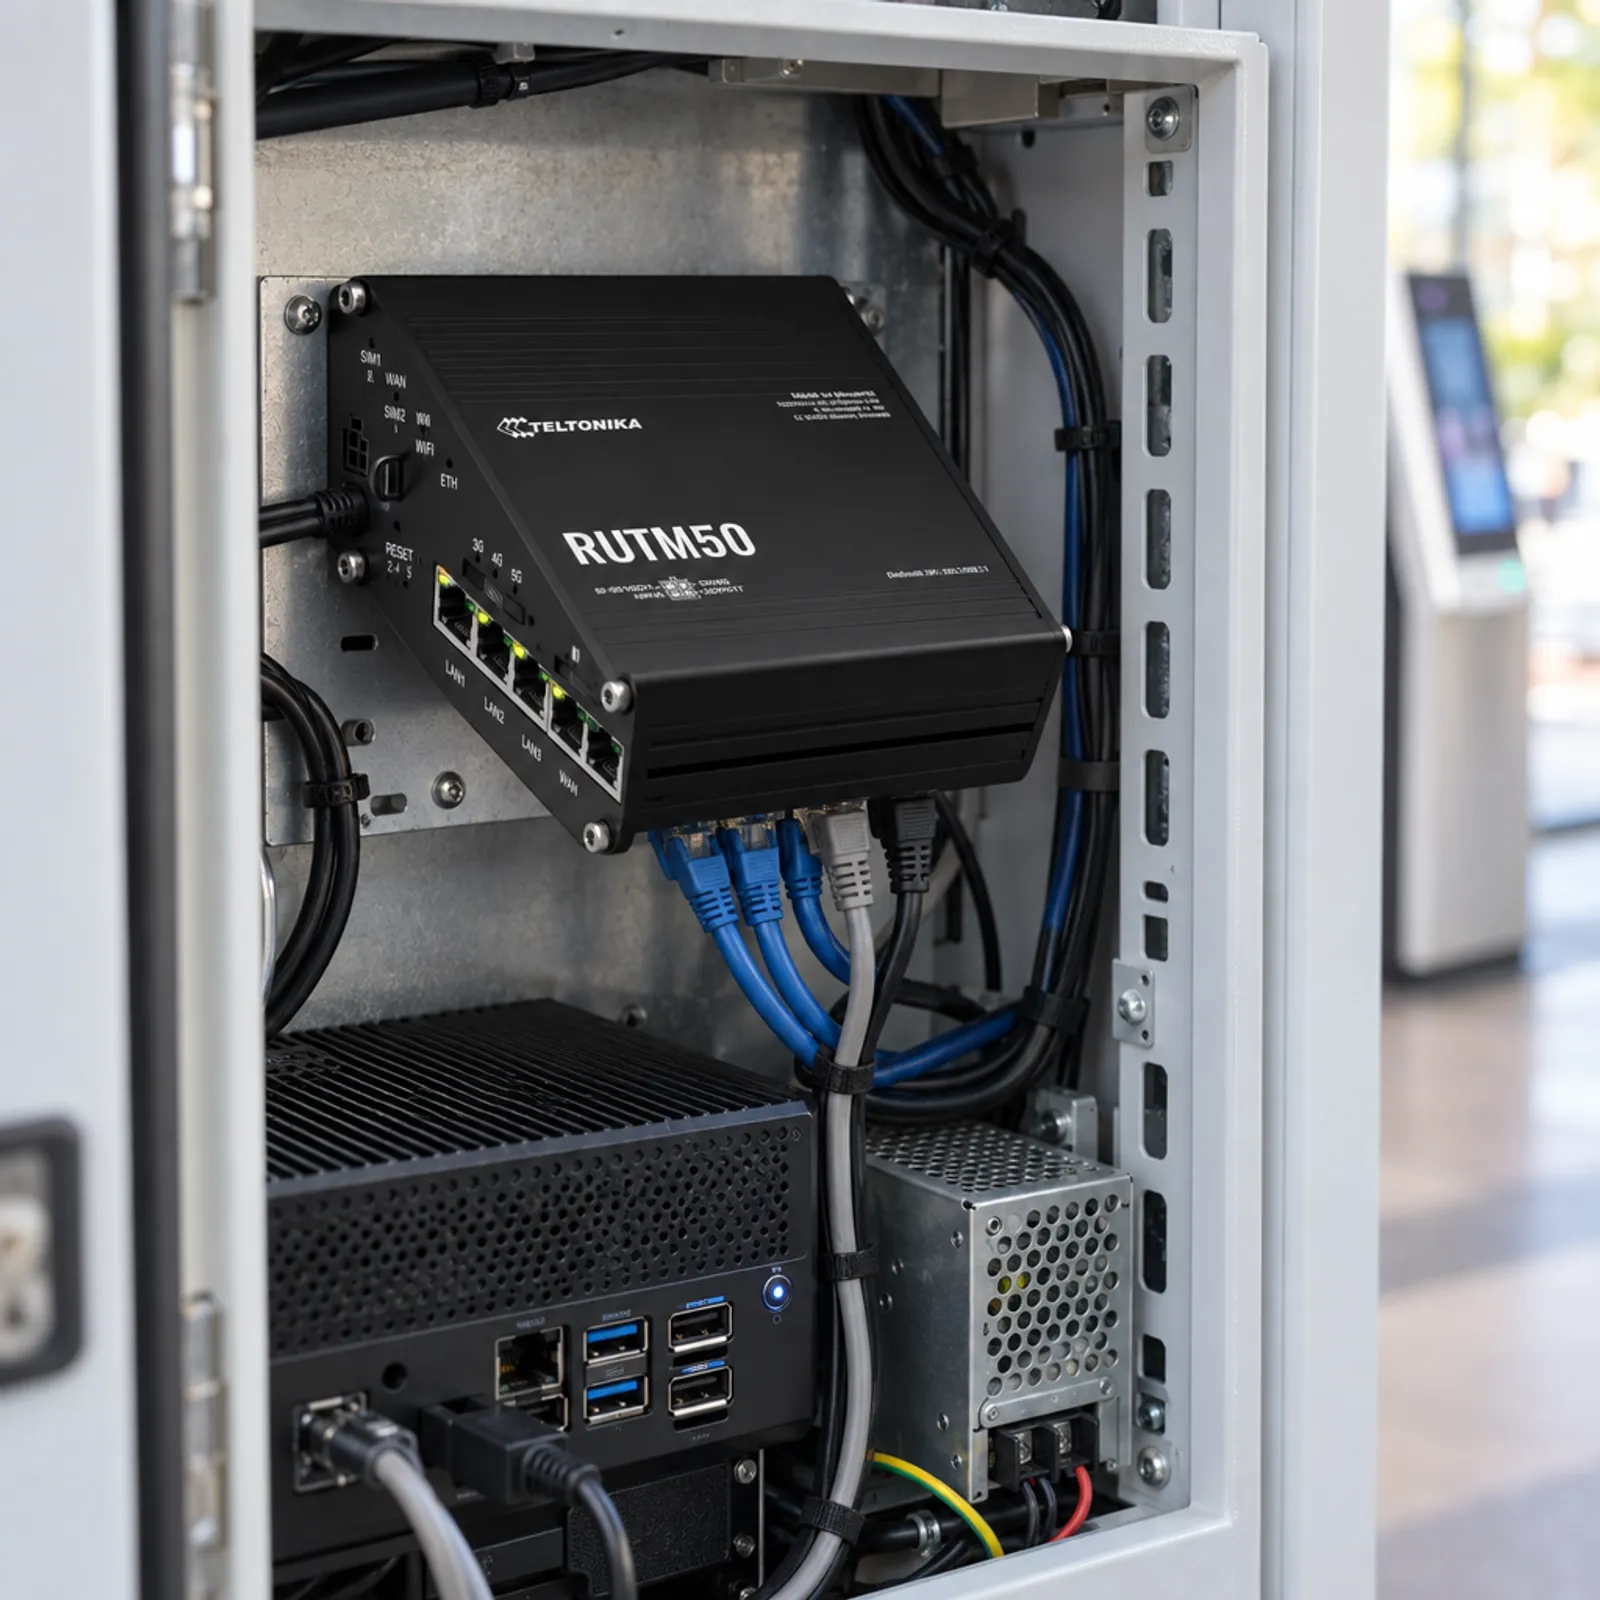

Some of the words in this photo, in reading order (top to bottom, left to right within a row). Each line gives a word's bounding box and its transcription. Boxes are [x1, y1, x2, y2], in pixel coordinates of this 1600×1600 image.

[360, 350, 381, 366] SIM1
[385, 372, 407, 388] WAN
[384, 405, 406, 423] SIM2
[528, 418, 643, 433] TELTONIKA
[440, 473, 458, 490] ETH
[385, 541, 413, 562] RESET
[472, 537, 484, 553] 3G
[562, 522, 756, 565] RUTM50
[491, 552, 503, 567] 4G
[511, 568, 522, 584] 5G
[445, 659, 466, 687] LAN1
[484, 696, 505, 725] LAN2
